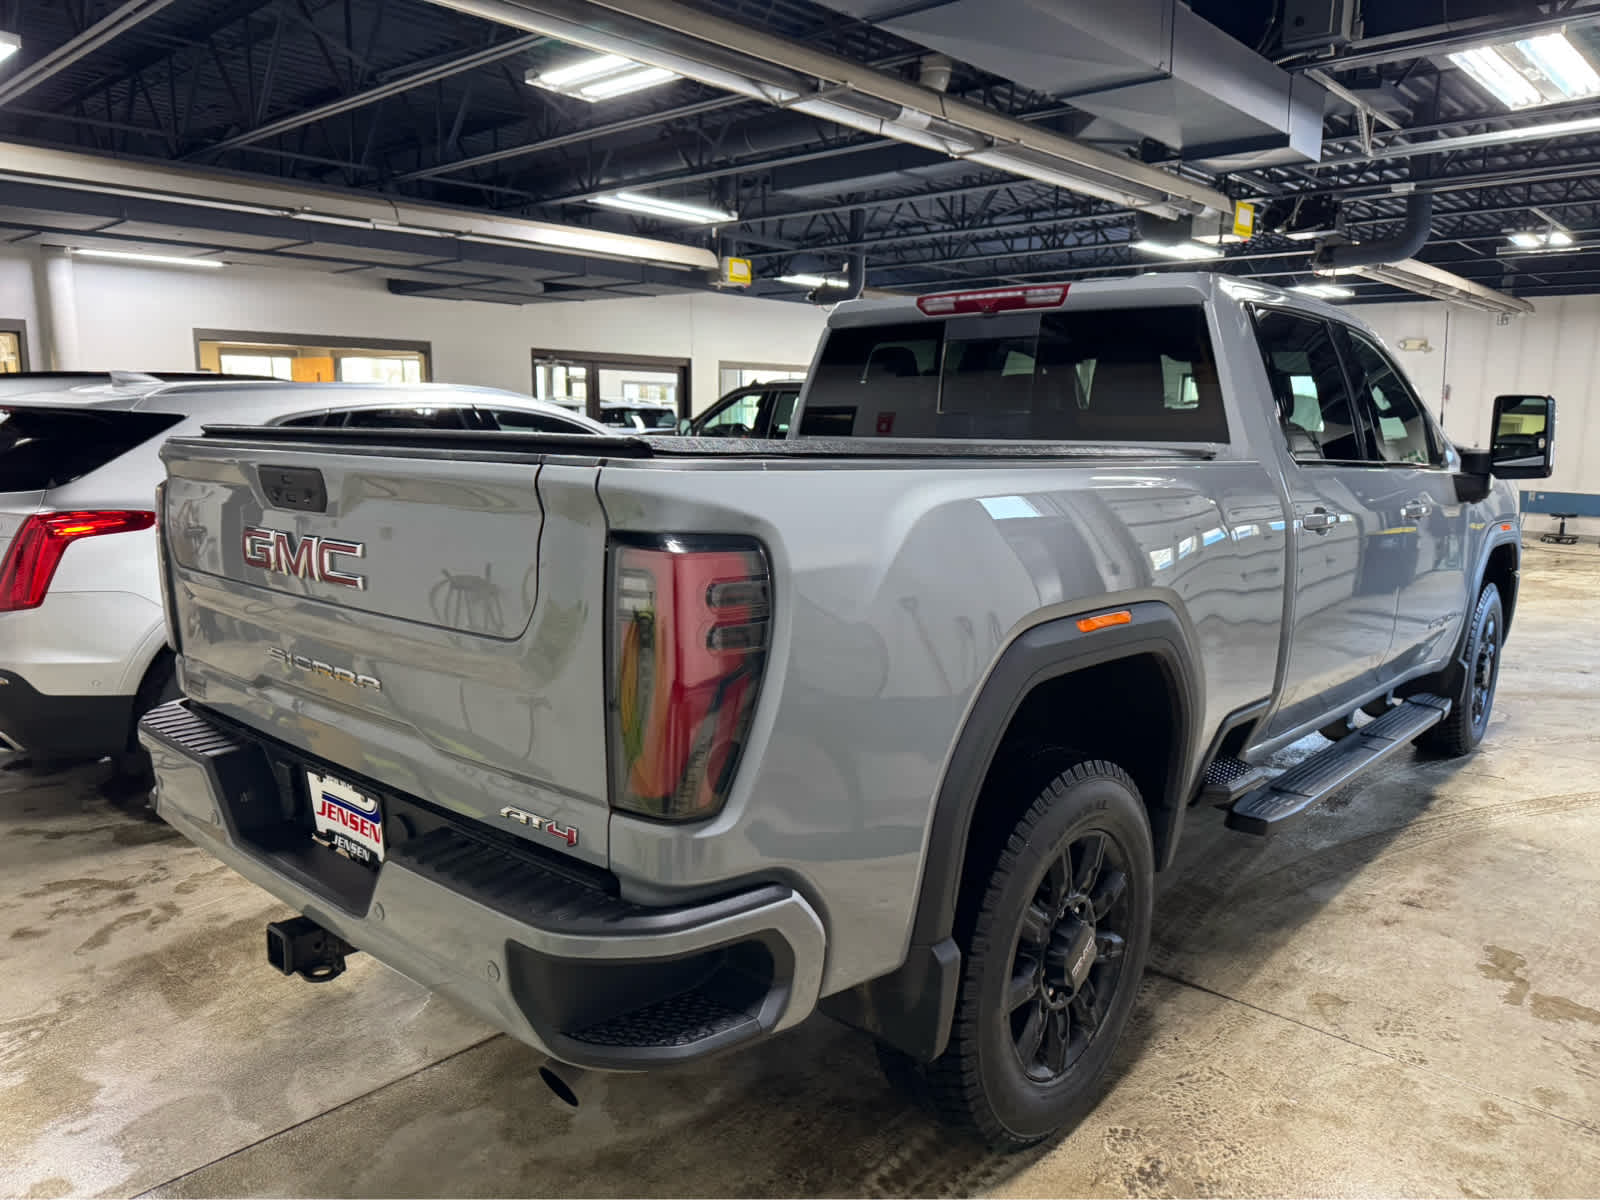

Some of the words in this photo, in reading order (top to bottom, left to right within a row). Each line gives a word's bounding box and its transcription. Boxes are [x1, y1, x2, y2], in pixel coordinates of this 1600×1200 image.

[242, 526, 365, 592] GMC
[264, 647, 382, 692] SIERRA
[316, 800, 381, 844] JENSEN
[500, 805, 578, 846] AT4
[331, 834, 370, 861] JENSEN
